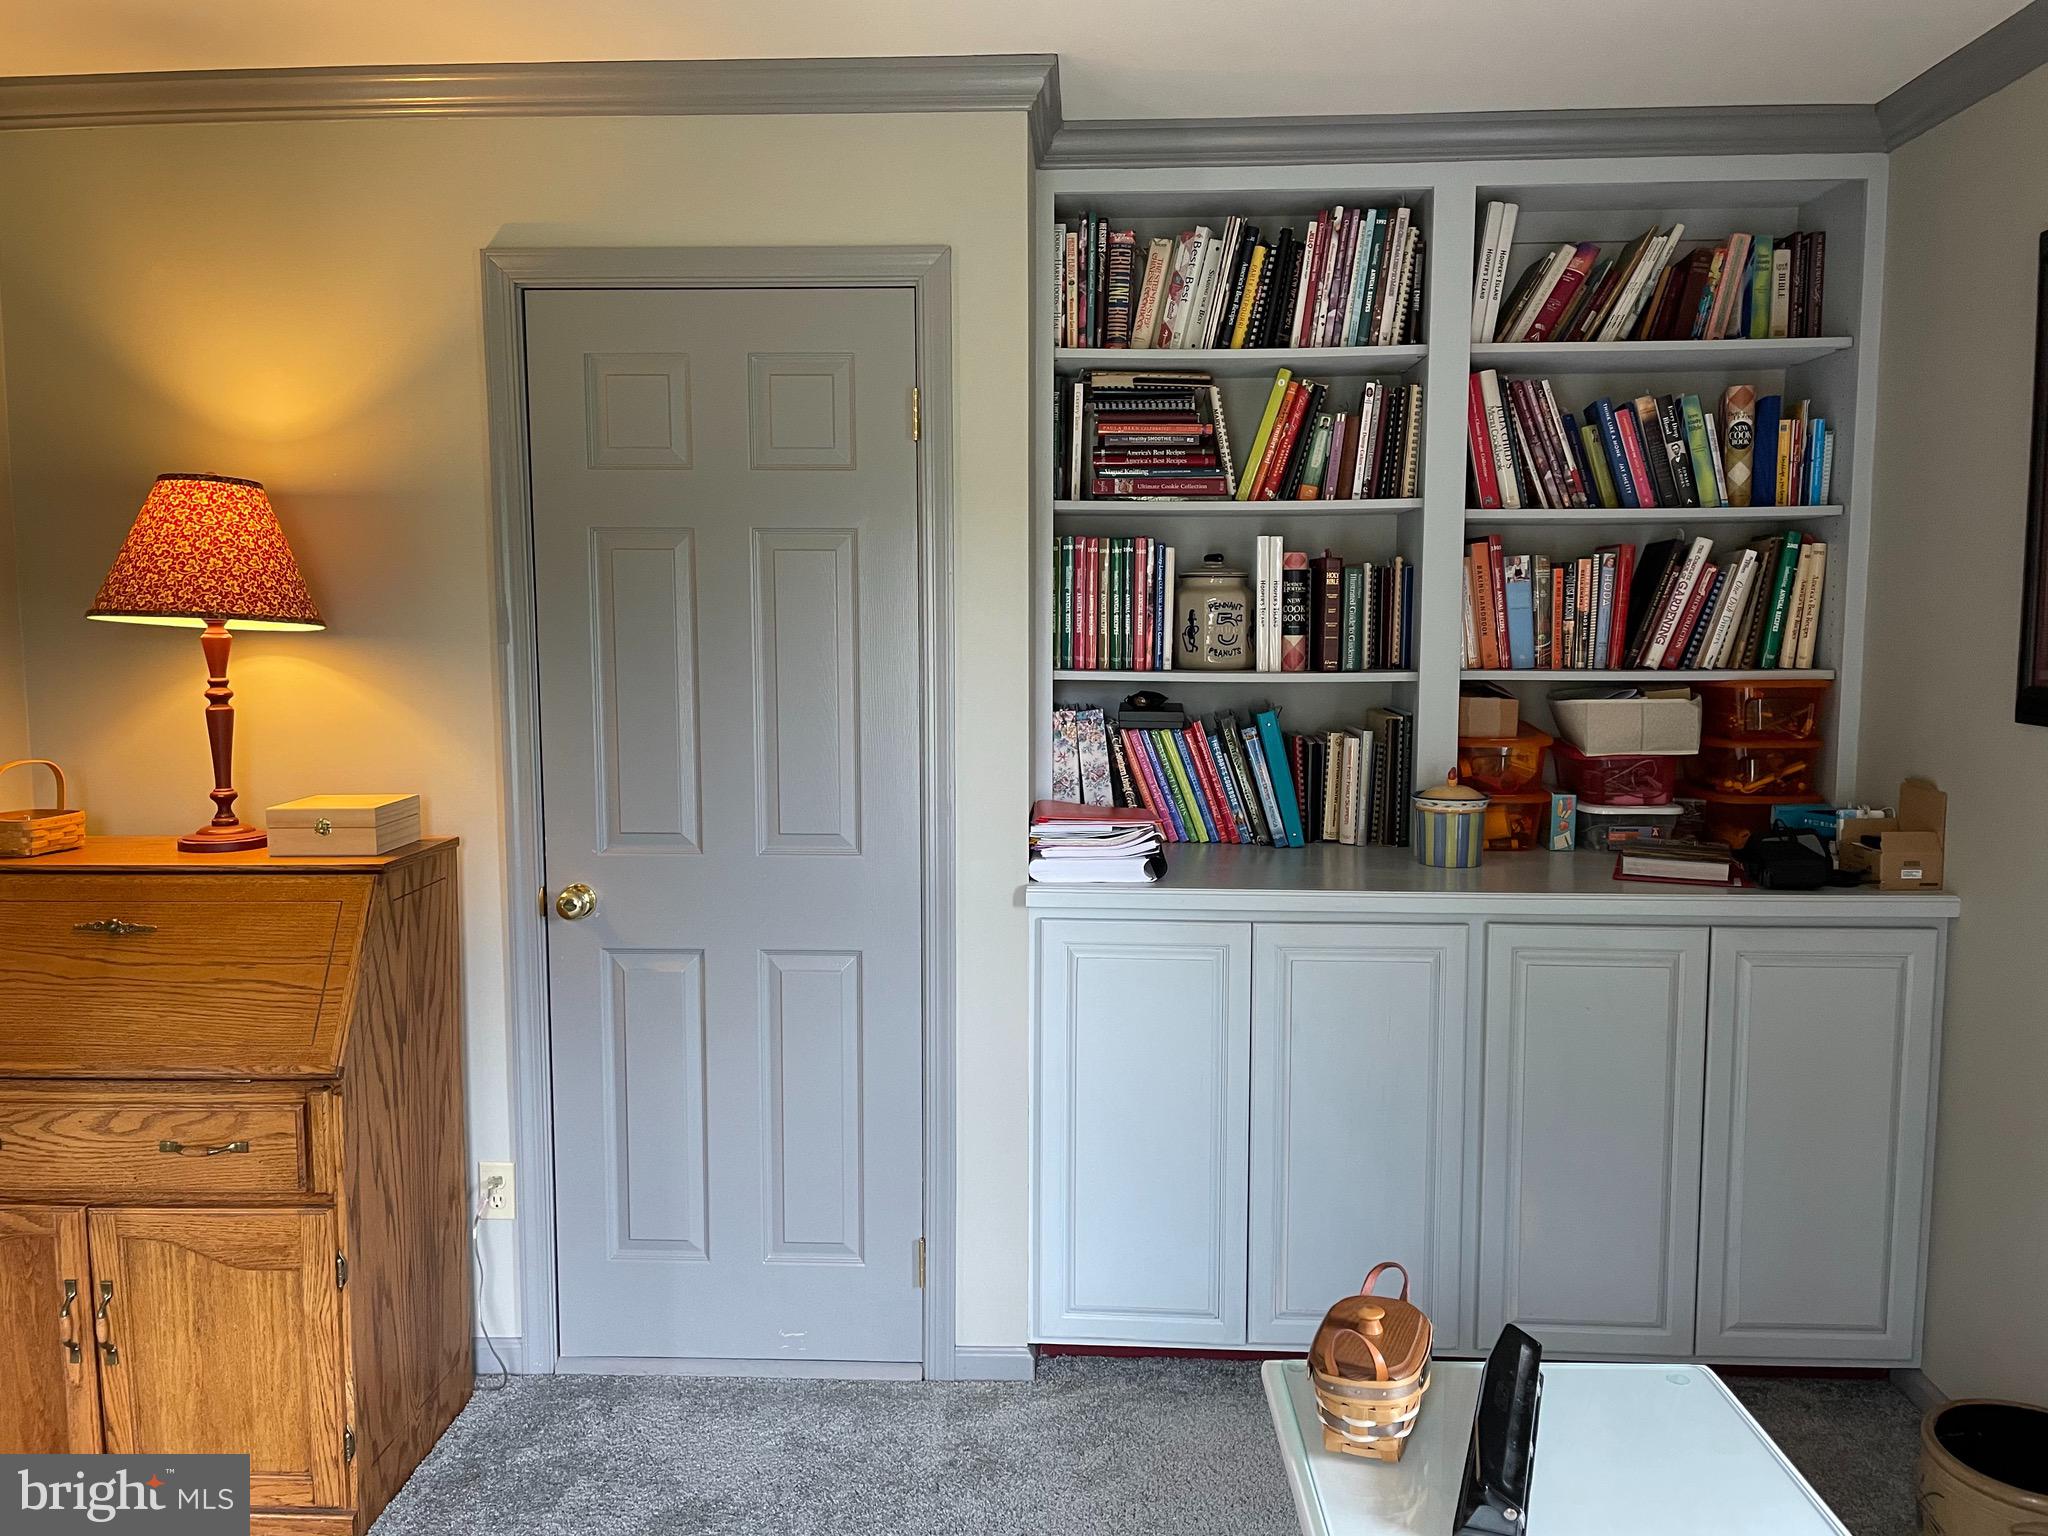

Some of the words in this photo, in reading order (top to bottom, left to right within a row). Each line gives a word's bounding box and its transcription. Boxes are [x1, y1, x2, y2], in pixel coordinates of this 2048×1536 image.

[1098, 223, 1107, 252] HERSHEY'S
[1188, 241, 1201, 268] Best
[1483, 248, 1493, 277] HOOPER'S
[1495, 250, 1507, 278] HOOPER'S
[1108, 248, 1131, 303] GRILLING
[1236, 262, 1248, 290] America's
[1368, 269, 1376, 290] ANNUAL
[1778, 273, 1786, 299] BIBLE
[1181, 276, 1194, 303] Best
[1233, 291, 1242, 303] Best
[1479, 278, 1489, 300] ISLAND
[1492, 280, 1501, 301] ISLAND
[1237, 289, 1252, 329] POTPOURRI
[1365, 291, 1374, 313] RECIPES
[1107, 307, 1129, 340] BOOK
[1196, 310, 1205, 325] BEST
[1228, 304, 1239, 326] Recipes
[1487, 406, 1497, 429] Menu
[1662, 417, 1671, 435] Blood
[1670, 422, 1680, 438] Drop
[1491, 430, 1505, 471] Cookbook
[1499, 432, 1512, 470] CHILD'S
[1603, 403, 1611, 420] THINK
[1607, 422, 1615, 434] LIKE
[1612, 441, 1621, 457] MONK
[1621, 473, 1631, 494] SHETTY
[1349, 573, 1357, 605] Illustrated
[1477, 565, 1485, 593] BAKING
[1602, 573, 1612, 608] HODA
[1733, 580, 1744, 595] One
[1808, 575, 1819, 603] America's
[1690, 595, 1701, 613] RECIPE
[1776, 589, 1786, 609] ANNUAL
[1798, 580, 1807, 605] America's
[1208, 602, 1244, 612] PENNANT
[1283, 605, 1305, 613] COOK
[1479, 595, 1487, 637] HANDBOOK
[1565, 596, 1574, 620] JACKSON
[1655, 581, 1688, 645] GARDENING
[1726, 597, 1737, 614] Dish
[1283, 614, 1305, 622] BOOK
[1713, 615, 1732, 645] Dinners
[1772, 611, 1782, 632] RECIPES
[1792, 619, 1800, 640] Recipes
[1802, 617, 1813, 638] Recipes
[1675, 614, 1694, 648] COLLECTION
[1208, 648, 1242, 657] PEANUTS
[1113, 752, 1127, 775] Southern
[1222, 776, 1238, 806] COOKBOOK
